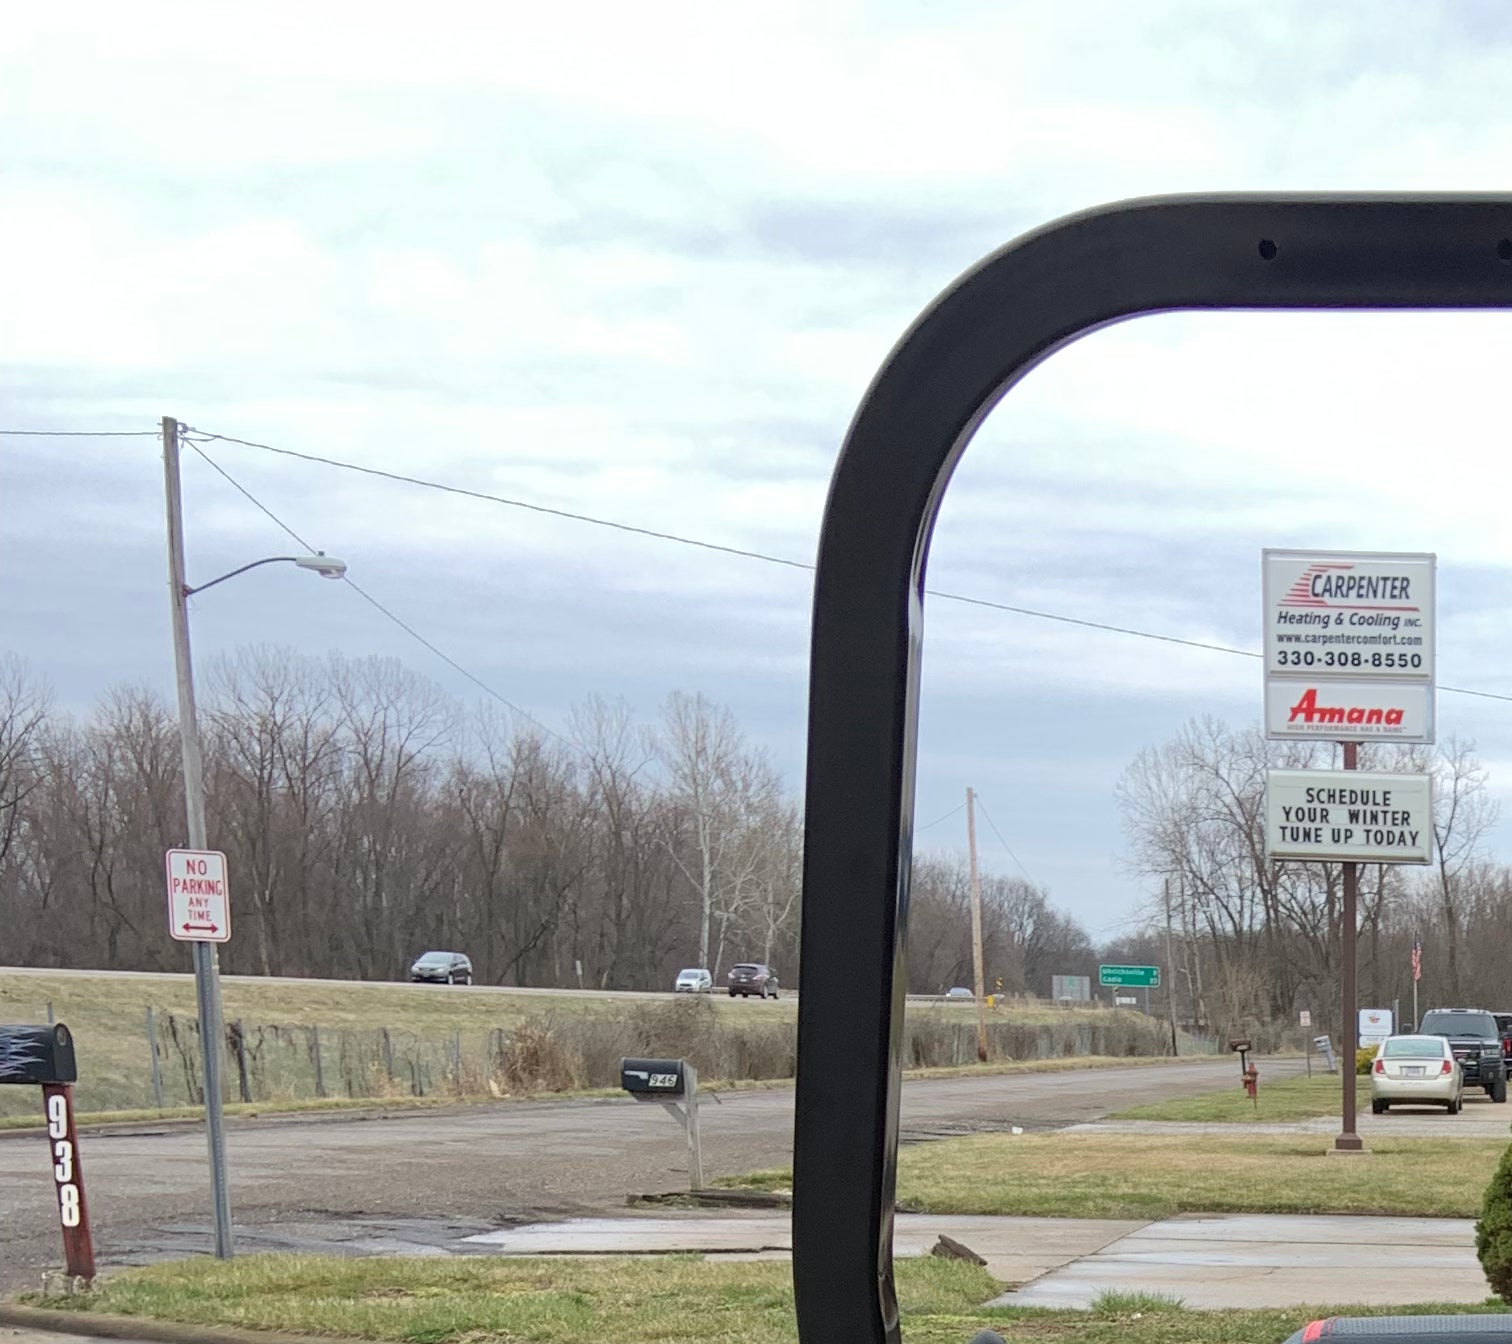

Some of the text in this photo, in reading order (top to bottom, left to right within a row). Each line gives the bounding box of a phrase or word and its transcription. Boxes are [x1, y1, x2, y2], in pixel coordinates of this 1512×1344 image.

[1311, 574, 1411, 600] CARPENTER
[1277, 611, 1331, 629] Heating
[1334, 612, 1345, 626] &
[1349, 612, 1401, 630] Cooling
[1276, 632, 1423, 646] www.carpentercomfort.com
[1277, 650, 1423, 669] 330-308-8550
[1288, 688, 1406, 726] Amana
[1306, 787, 1392, 807] SCHEDULE
[1282, 806, 1411, 827] YOUR WINTER
[1279, 826, 1420, 847] TUNE UP TODAY
[186, 859, 208, 876] NO
[173, 877, 223, 896] PARKING
[187, 897, 209, 908] ANY
[187, 909, 212, 922] TIME
[650, 1074, 676, 1086] 946
